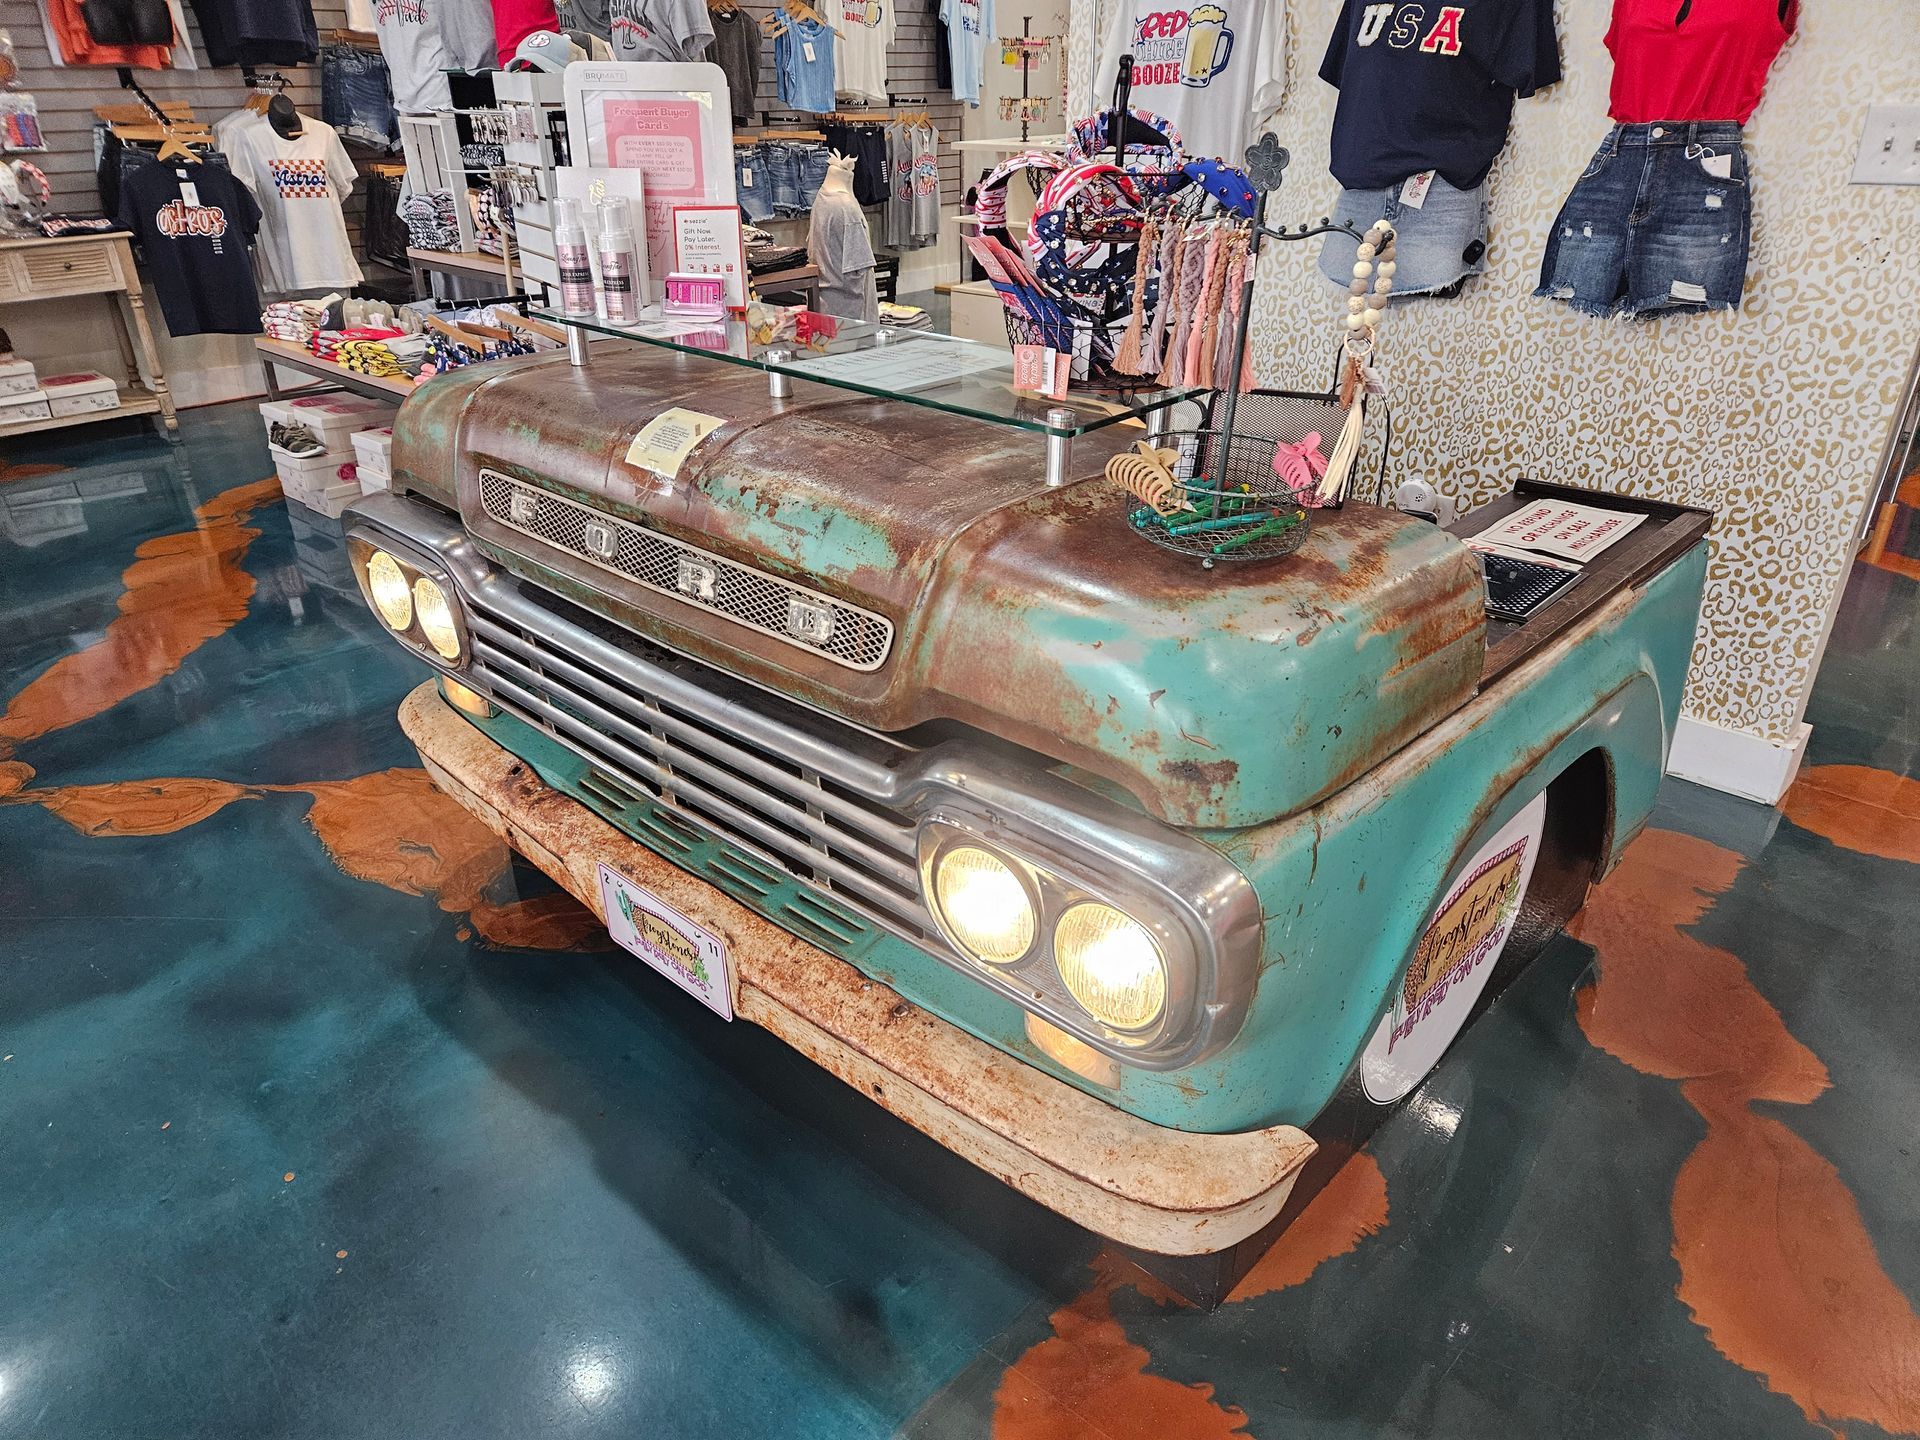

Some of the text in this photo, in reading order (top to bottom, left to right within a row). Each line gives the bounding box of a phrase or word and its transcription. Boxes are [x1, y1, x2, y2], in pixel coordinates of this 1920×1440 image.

[1141, 10, 1189, 38] RED
[1357, 4, 1465, 56] USA
[1131, 62, 1181, 87] BOOZE
[614, 107, 690, 119] Frequent Buyer
[637, 121, 669, 130] Cards
[1503, 508, 1552, 534] NO REFUND
[1521, 510, 1578, 542] OR EXCHANGE
[1554, 520, 1591, 540] ON SALE
[1567, 519, 1622, 550] MERCHANDISE
[510, 487, 837, 643] FORD
[604, 873, 610, 885] 2
[1452, 952, 1476, 984] ON
[1474, 926, 1506, 966] GOD
[686, 972, 707, 992] GOD
